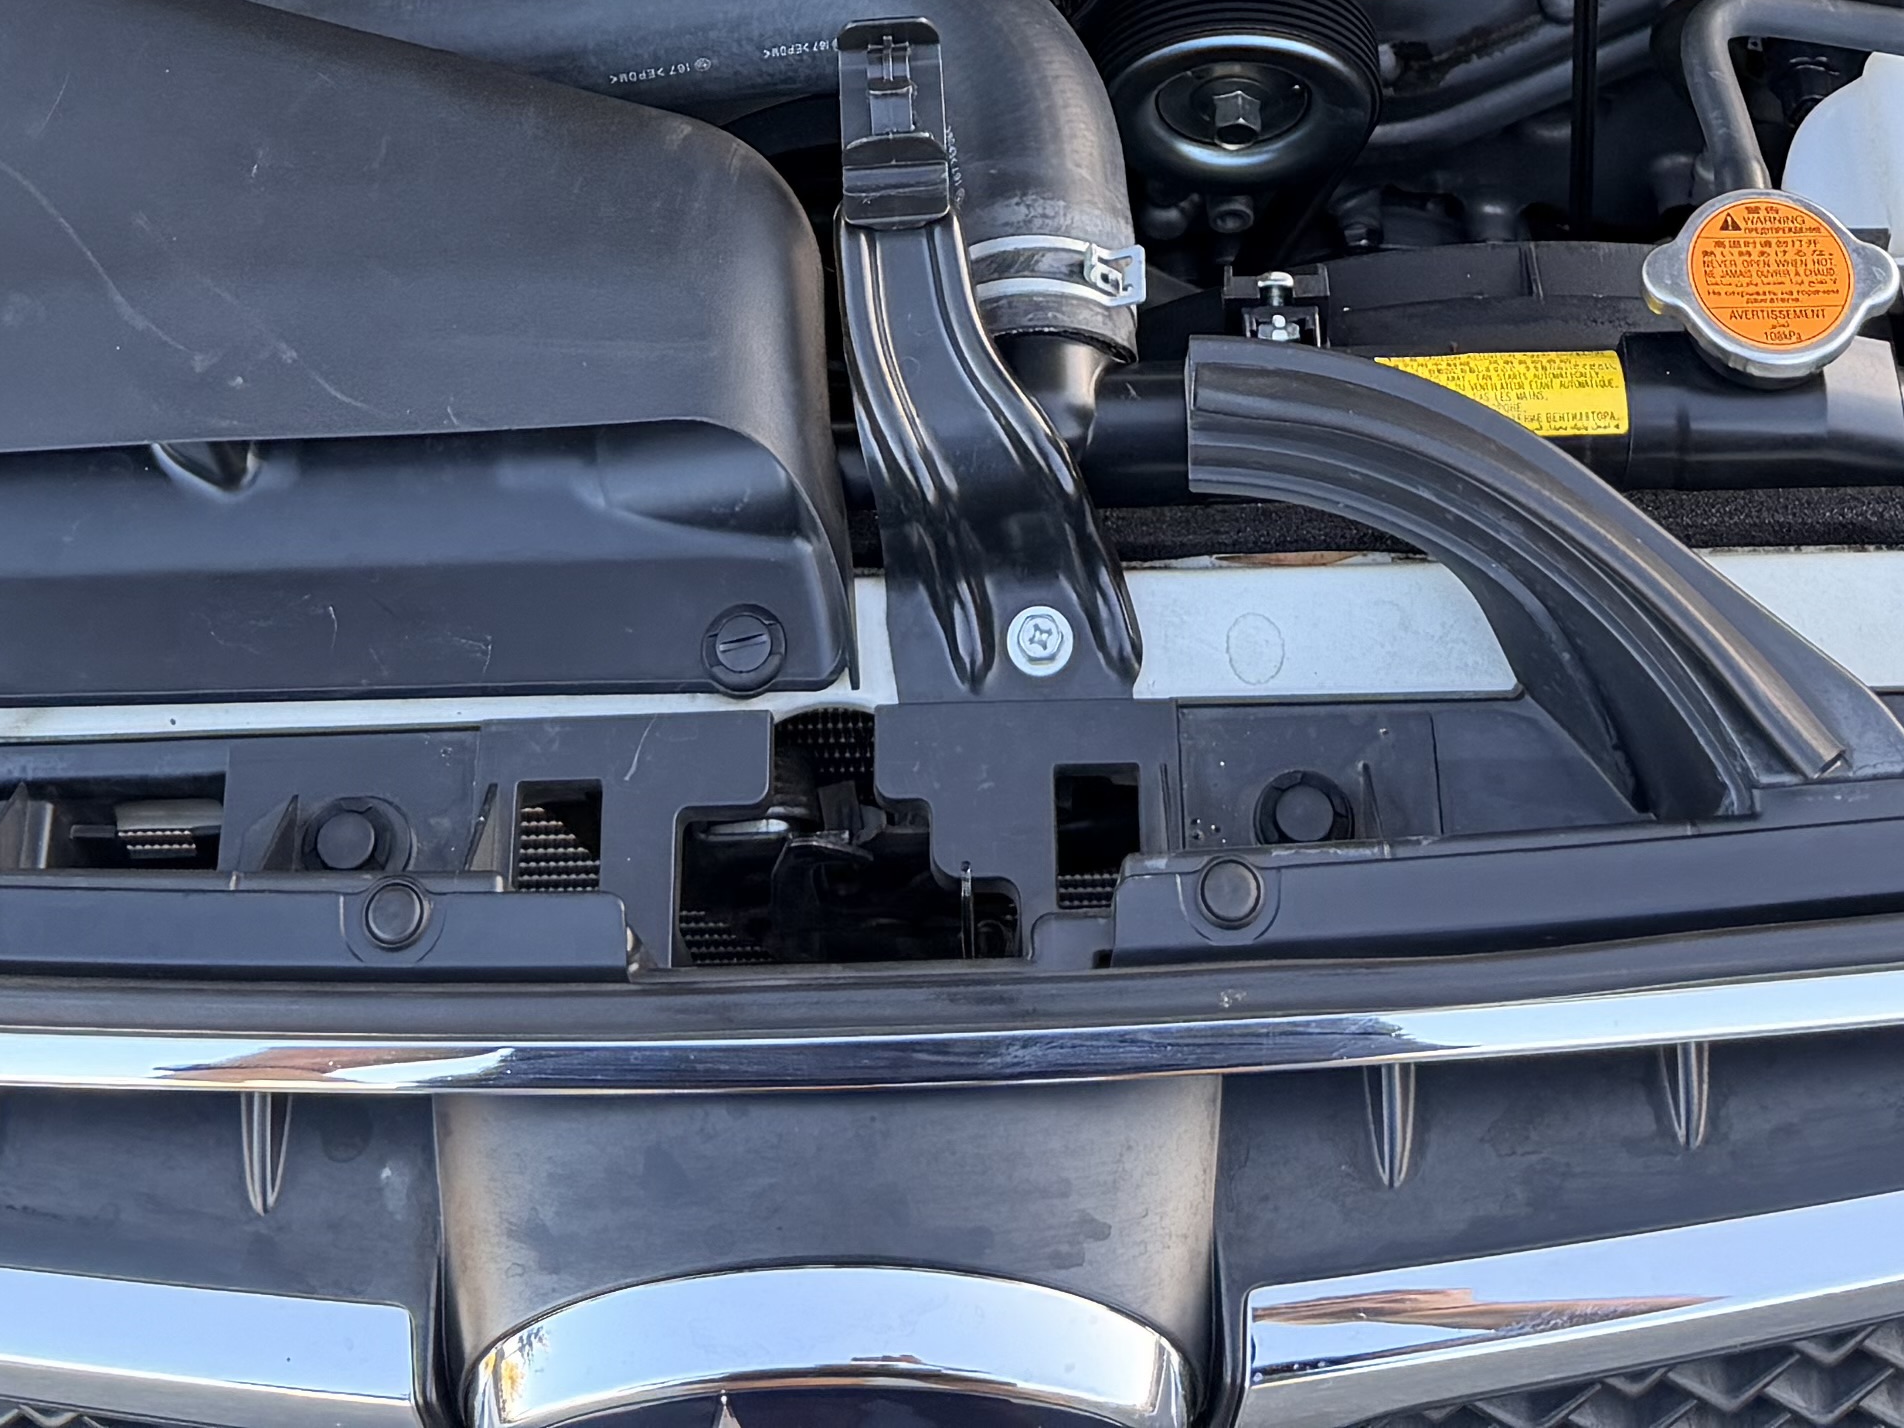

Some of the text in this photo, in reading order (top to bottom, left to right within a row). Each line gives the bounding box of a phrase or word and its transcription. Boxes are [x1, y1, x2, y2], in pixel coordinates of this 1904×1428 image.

[1743, 215, 1806, 226] WARNING
[1703, 260, 1738, 269] NEVER
[1742, 259, 1771, 269] OPEN
[1775, 259, 1808, 268] WHEN
[1729, 308, 1827, 321] AVERTISSEMENT
[1476, 373, 1495, 382] FAN
[1497, 373, 1530, 383] STARTS
